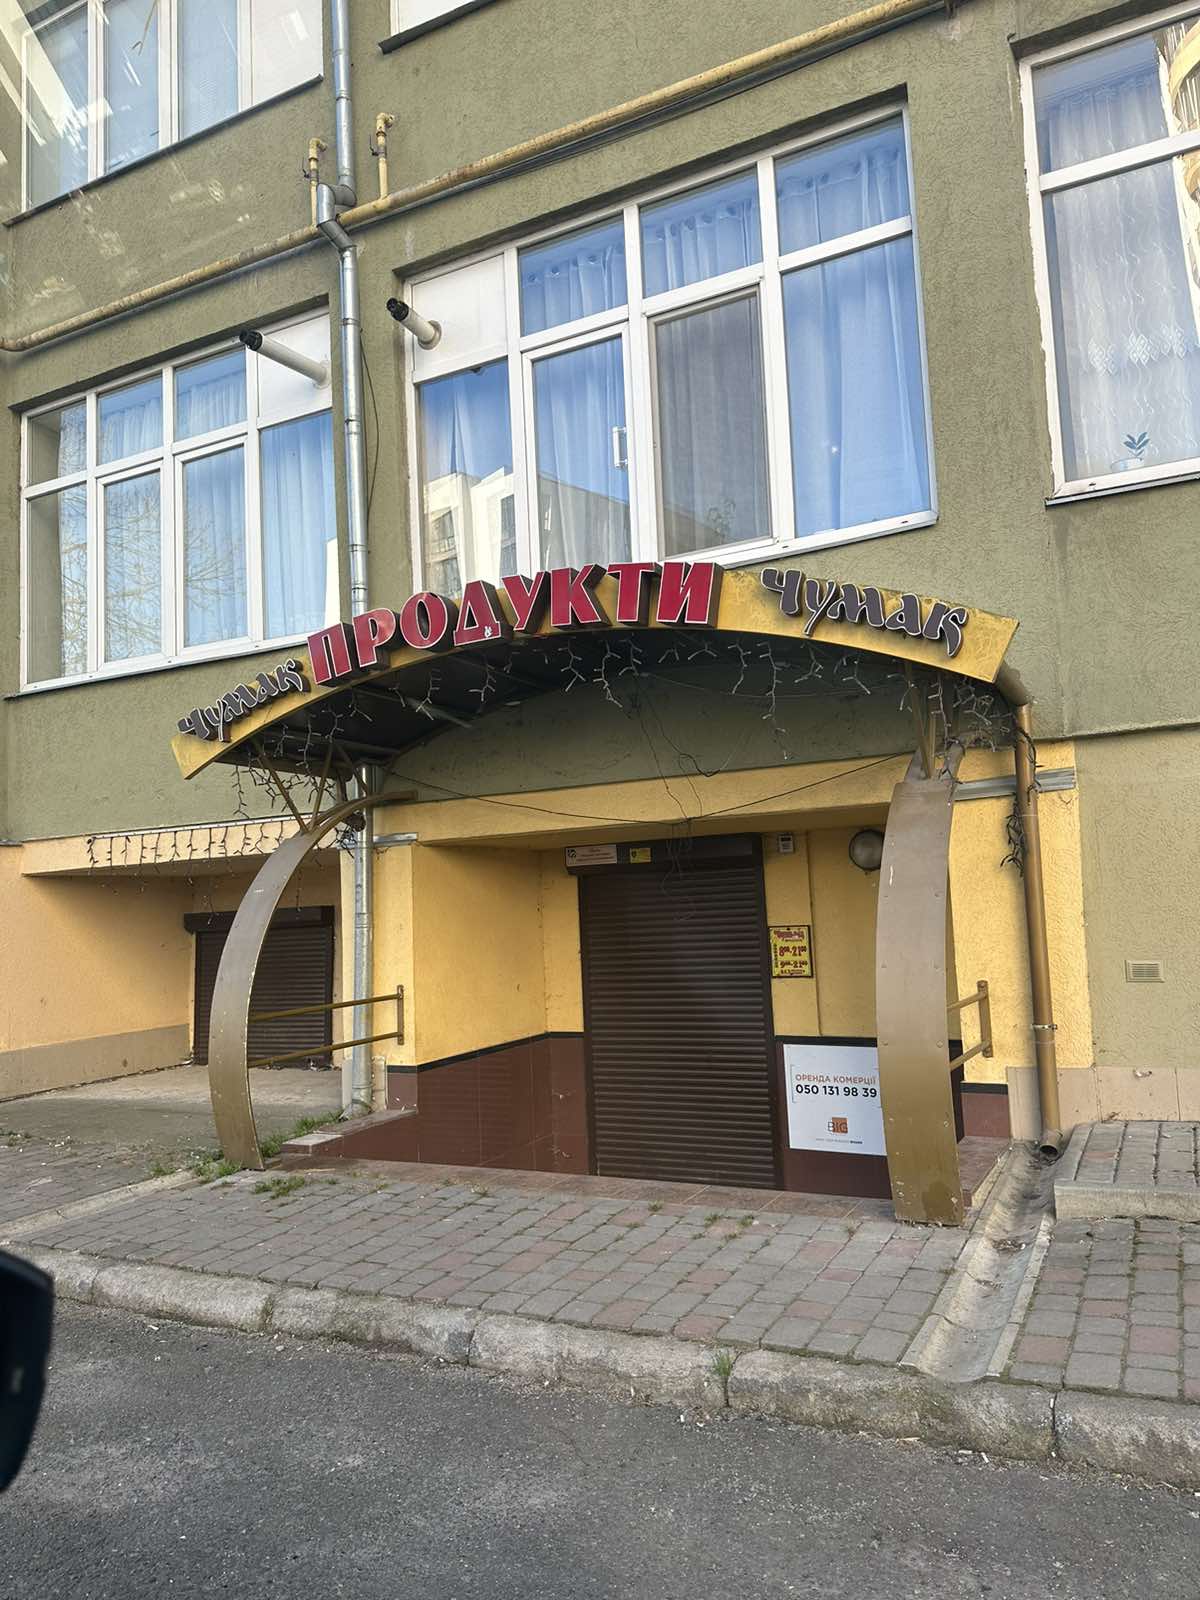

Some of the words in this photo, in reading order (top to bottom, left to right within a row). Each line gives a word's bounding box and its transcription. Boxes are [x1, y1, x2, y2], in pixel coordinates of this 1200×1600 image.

[177, 659, 311, 742] Чумак
[307, 561, 722, 686] ПРОДУКТИ
[760, 567, 968, 658] Чумак
[795, 1074, 831, 1084] ОРЕНДА
[833, 1075, 876, 1086] КОМЕРЦІЇ
[795, 1084, 819, 1095] 050
[822, 1085, 840, 1096] 131
[843, 1086, 859, 1097] 98
[862, 1087, 877, 1098] 39
[827, 1121, 848, 1133] BIG
